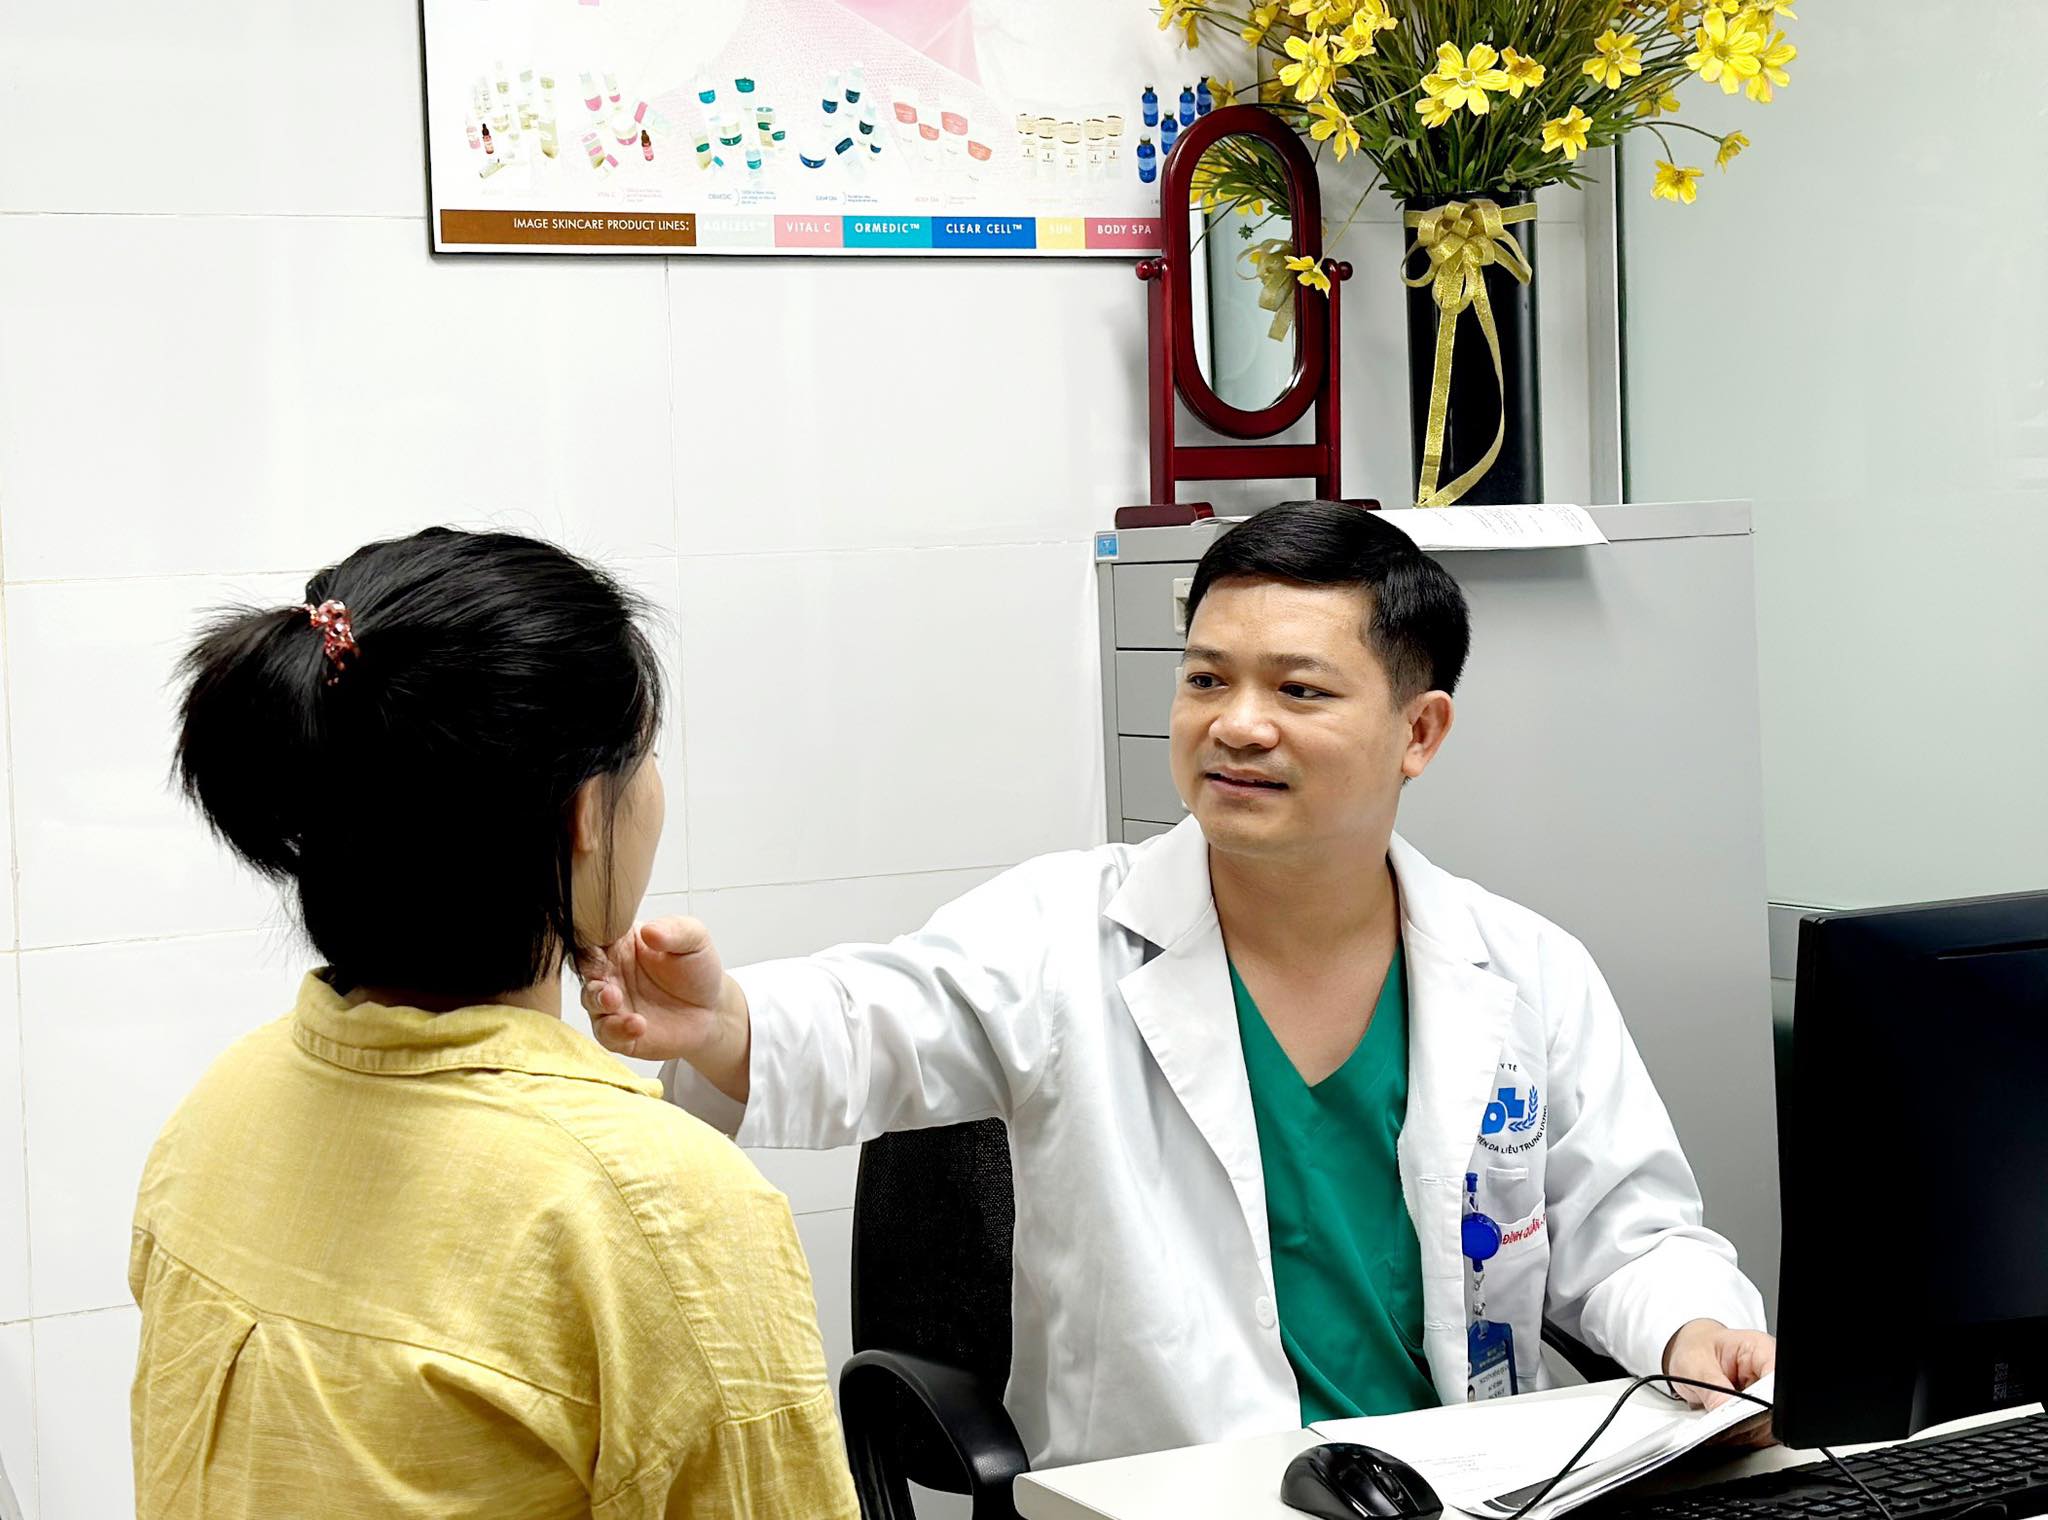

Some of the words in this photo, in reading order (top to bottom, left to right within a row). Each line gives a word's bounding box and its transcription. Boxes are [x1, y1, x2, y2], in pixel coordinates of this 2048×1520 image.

[513, 218, 549, 229] IMAGE
[552, 219, 604, 230] SKINCARE
[607, 220, 655, 231] PRODUCT
[658, 221, 690, 231] LINES:
[786, 222, 820, 233] VITAL
[824, 222, 832, 233] C
[945, 223, 982, 235] CLEAR
[1097, 223, 1127, 235] BODY
[1131, 223, 1153, 235] SPA
[1488, 1143, 1500, 1153] DA
[1518, 1131, 1543, 1152] TRUNG
